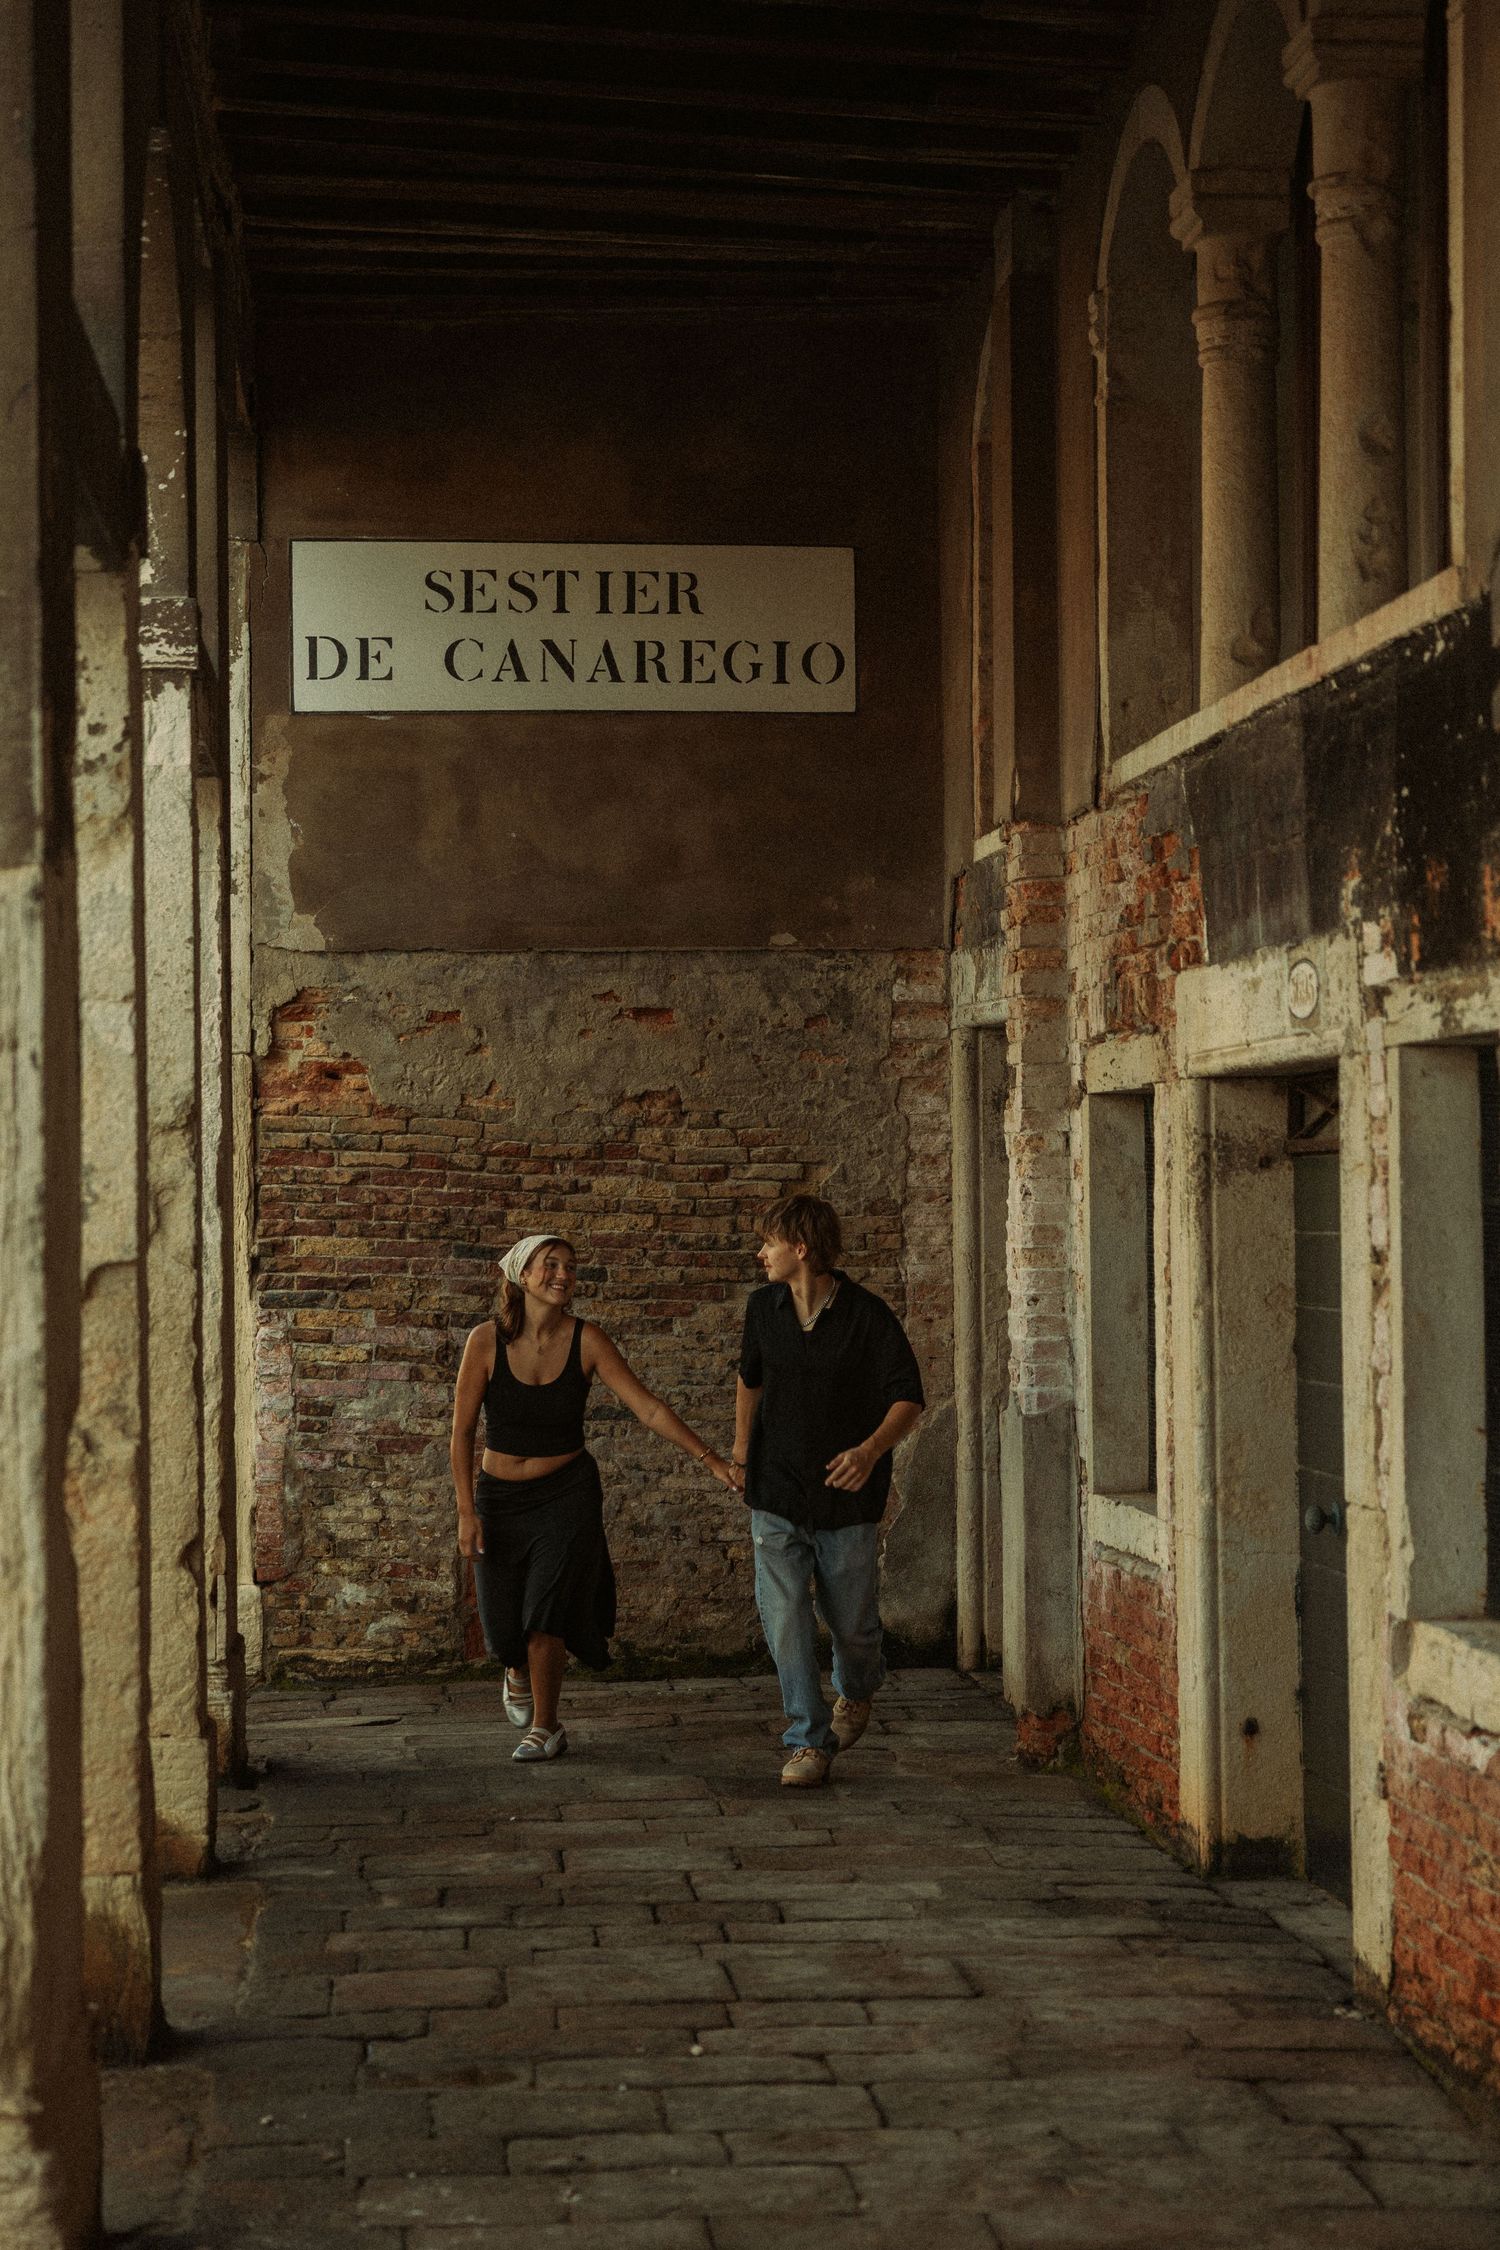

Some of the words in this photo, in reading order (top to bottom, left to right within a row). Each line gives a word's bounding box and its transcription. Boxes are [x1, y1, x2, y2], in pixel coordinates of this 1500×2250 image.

[424, 569, 703, 615] SESTIER
[305, 636, 393, 681] DE
[443, 638, 846, 685] CANAREGIO
